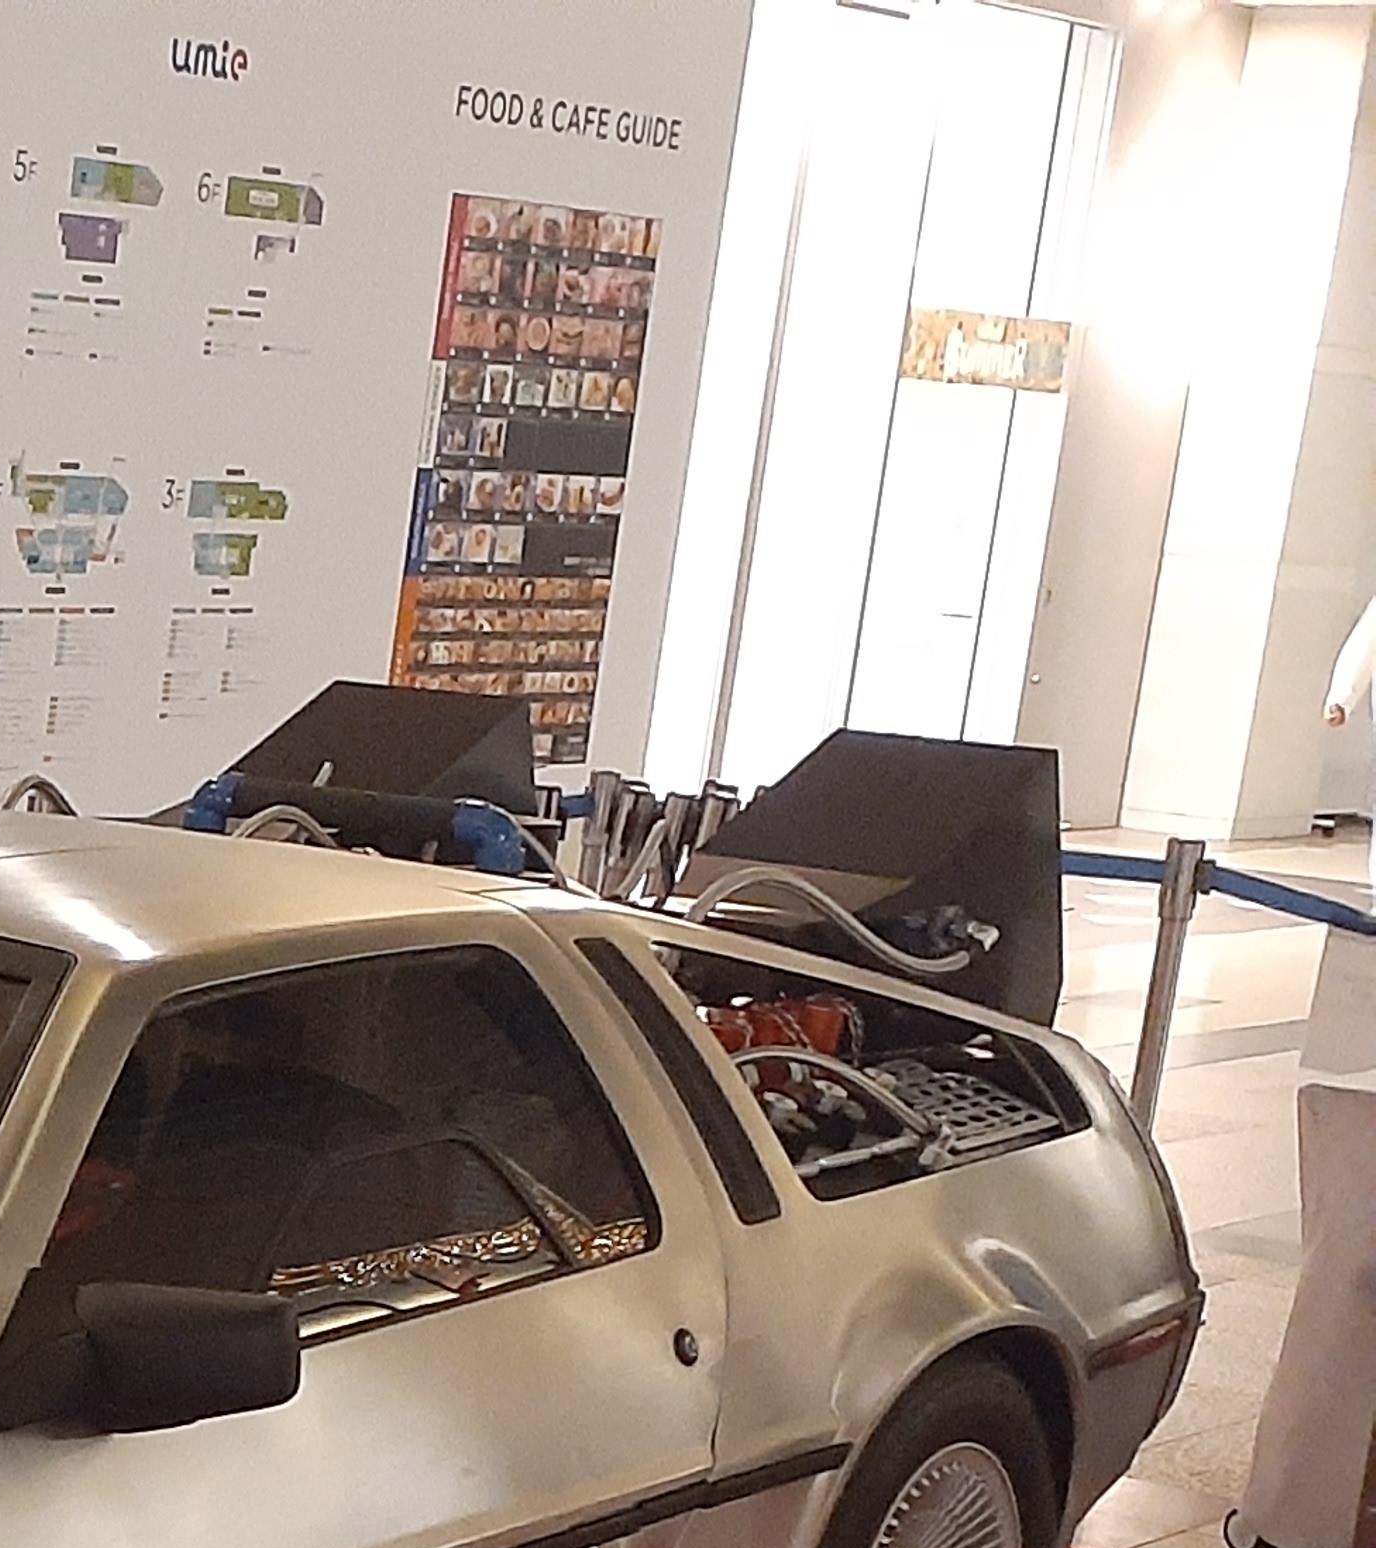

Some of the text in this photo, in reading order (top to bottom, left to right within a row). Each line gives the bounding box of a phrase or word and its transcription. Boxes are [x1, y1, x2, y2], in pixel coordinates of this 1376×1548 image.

[171, 37, 248, 81] umie
[455, 85, 682, 150] FOOD & CAFE GUIDE
[13, 149, 38, 182] 5F
[197, 172, 222, 203] 6F
[161, 479, 186, 510] 3F
